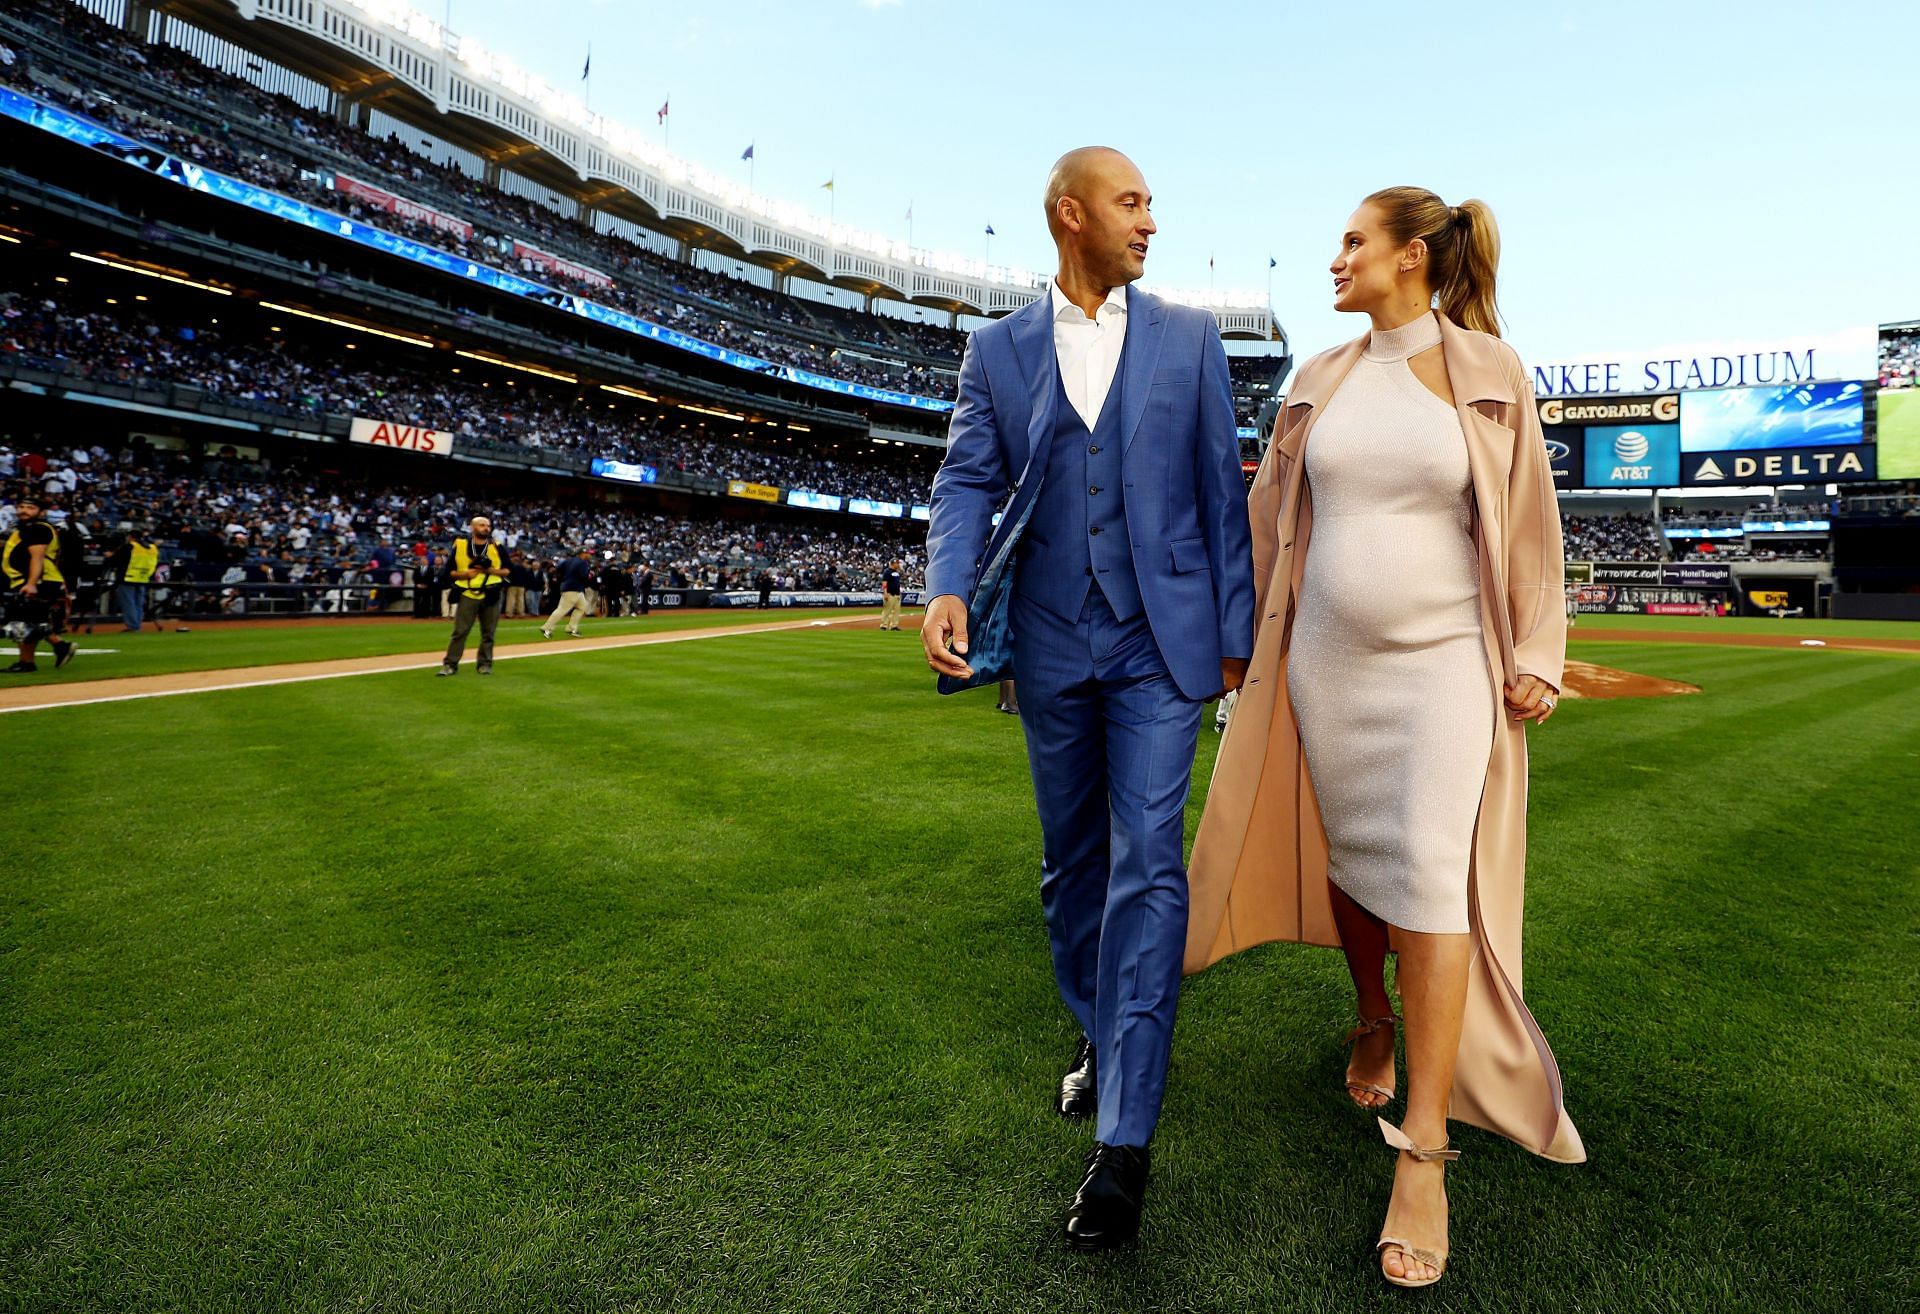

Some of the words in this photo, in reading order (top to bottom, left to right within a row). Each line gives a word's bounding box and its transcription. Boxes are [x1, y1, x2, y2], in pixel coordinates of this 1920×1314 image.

[1533, 363, 1621, 395] NKEE
[1643, 348, 1816, 392] STADIUM
[1564, 404, 1651, 420] GATORADE
[369, 422, 436, 453] AVIS
[1610, 466, 1652, 481] AT&T
[1734, 452, 1864, 477] DELTA
